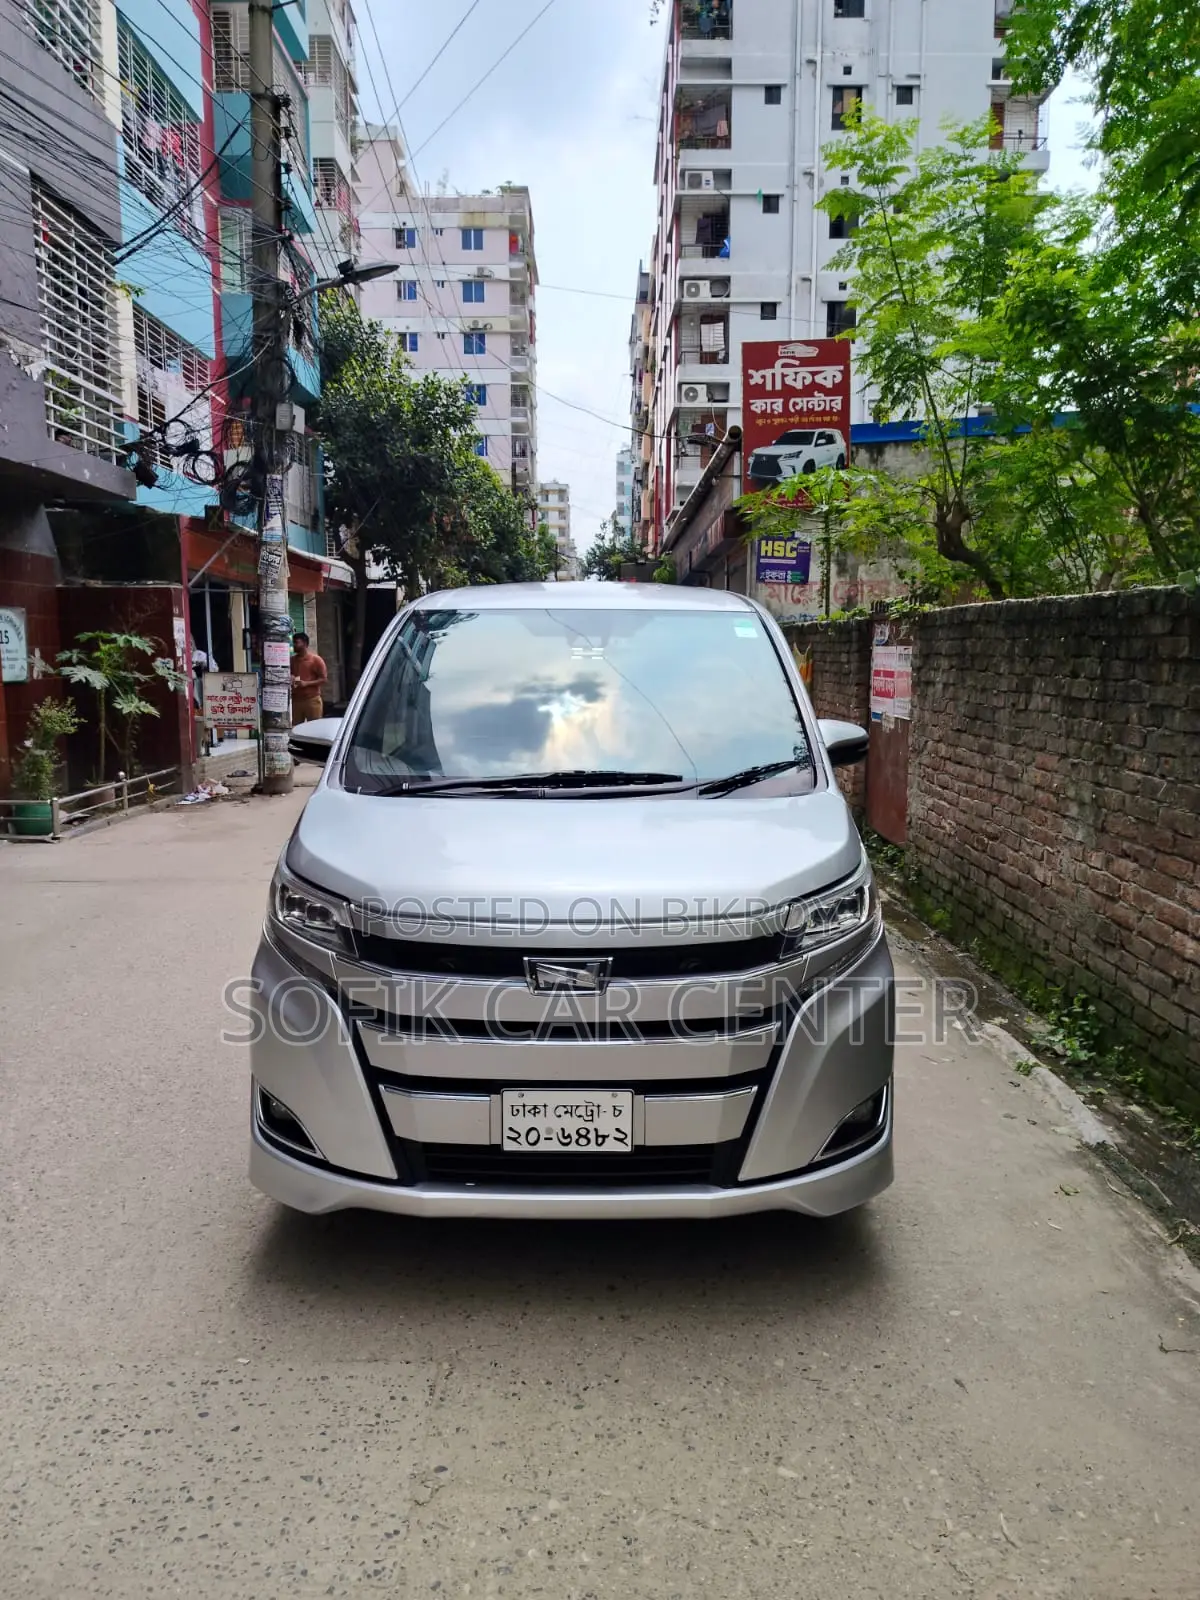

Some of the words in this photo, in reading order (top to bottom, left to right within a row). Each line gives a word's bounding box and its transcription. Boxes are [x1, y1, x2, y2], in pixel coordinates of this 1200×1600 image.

[748, 358, 844, 391] শফিক
[749, 398, 784, 414] কার
[789, 390, 843, 413] সেন্টার
[760, 540, 798, 558] HSC
[509, 1102, 549, 1119] ঢাকা
[506, 1126, 630, 1147] ২০-৬৪৮২
